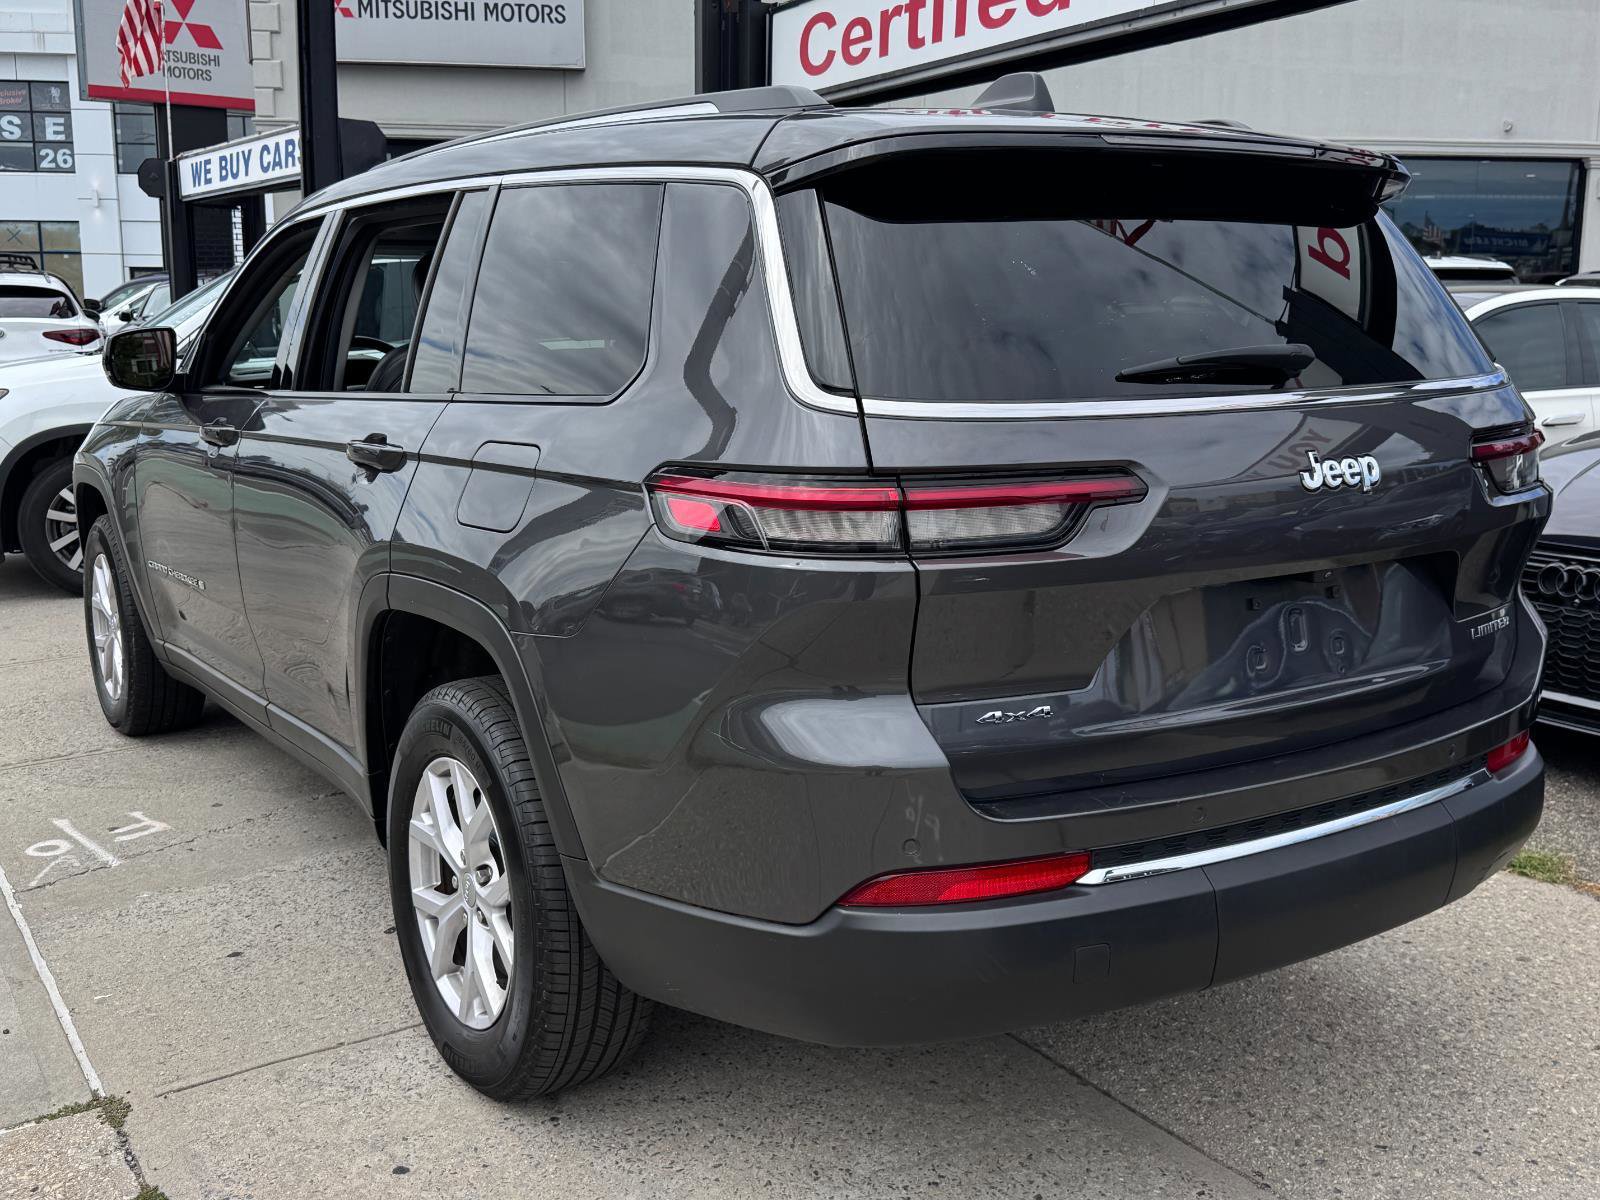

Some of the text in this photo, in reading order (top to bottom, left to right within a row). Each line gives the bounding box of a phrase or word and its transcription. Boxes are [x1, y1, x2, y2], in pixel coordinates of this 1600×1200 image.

[358, 0, 567, 24] MITSUBISHI MOTORS
[40, 148, 73, 169] 26
[191, 138, 301, 188] WE BUY CAR
[1299, 450, 1380, 493] Jeep
